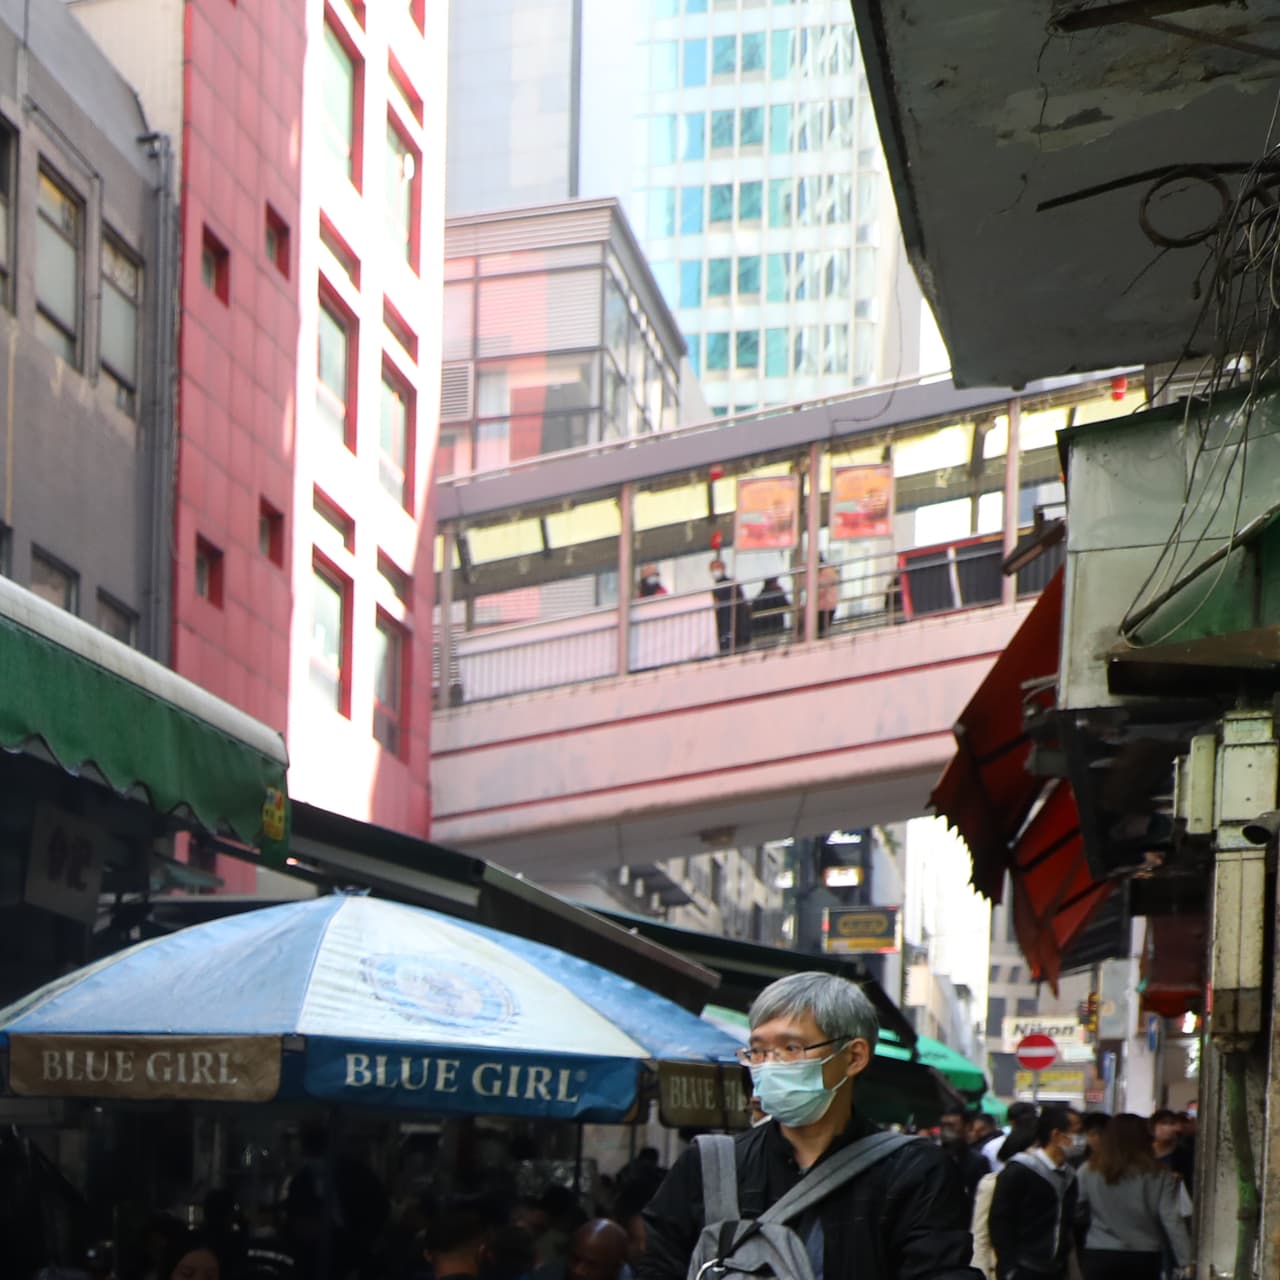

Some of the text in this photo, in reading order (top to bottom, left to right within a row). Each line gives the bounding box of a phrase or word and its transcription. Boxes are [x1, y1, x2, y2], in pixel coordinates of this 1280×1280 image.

[1013, 1023, 1075, 1036] Nikon
[42, 1050, 239, 1085] BLUE GIRL
[344, 1053, 579, 1103] BLUE GIRL
